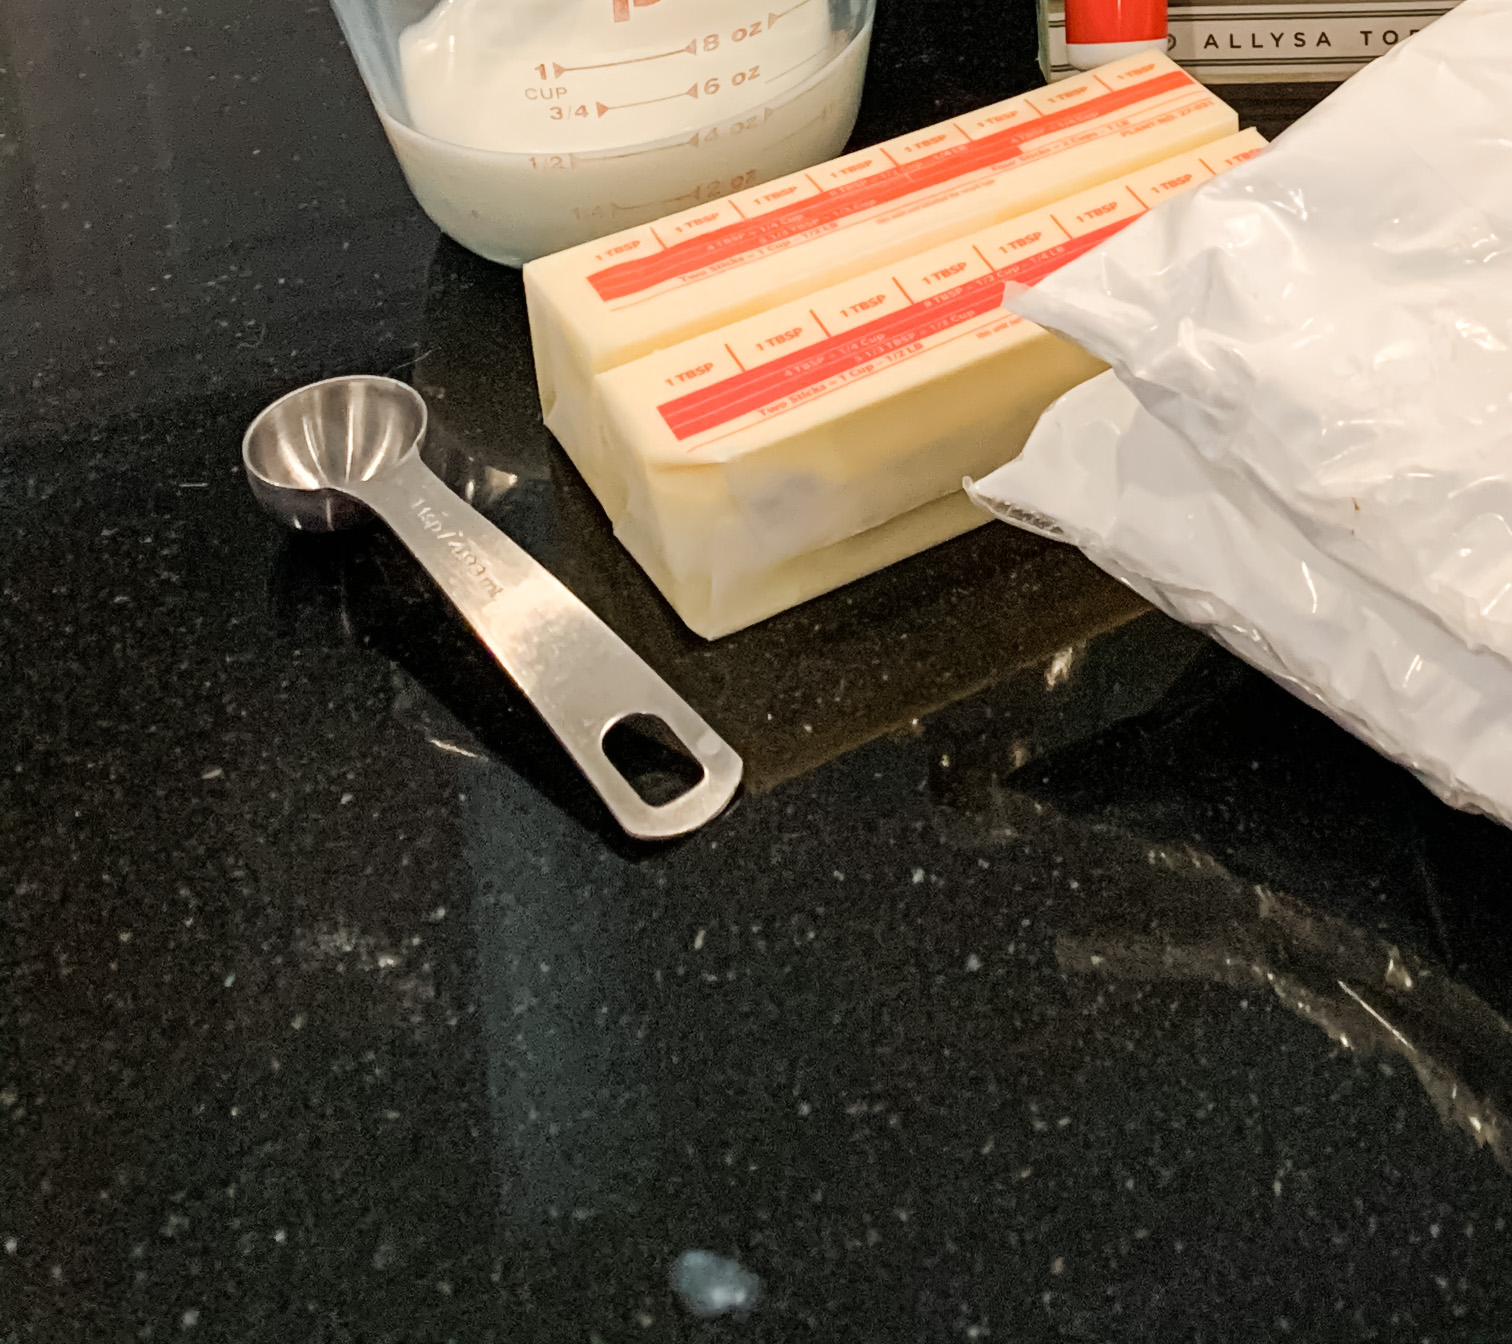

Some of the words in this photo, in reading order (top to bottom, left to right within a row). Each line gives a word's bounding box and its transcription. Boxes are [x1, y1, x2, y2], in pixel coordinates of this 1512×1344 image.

[702, 33, 720, 53] 8
[731, 20, 763, 44] oz
[1203, 31, 1332, 50] ALLYSA
[703, 77, 721, 96] 6
[731, 65, 761, 88] oz
[524, 87, 569, 102] CUP
[549, 104, 590, 121] 3/4
[1160, 173, 1193, 191] TBSP
[1084, 201, 1119, 219] TBSP
[683, 212, 720, 230] TBSP
[602, 239, 642, 258] TBSP
[1007, 231, 1043, 250] TBSP
[931, 261, 968, 281] TBSP
[848, 294, 887, 314] TBSP
[764, 327, 804, 347] TBSP
[674, 362, 714, 383] TBSP
